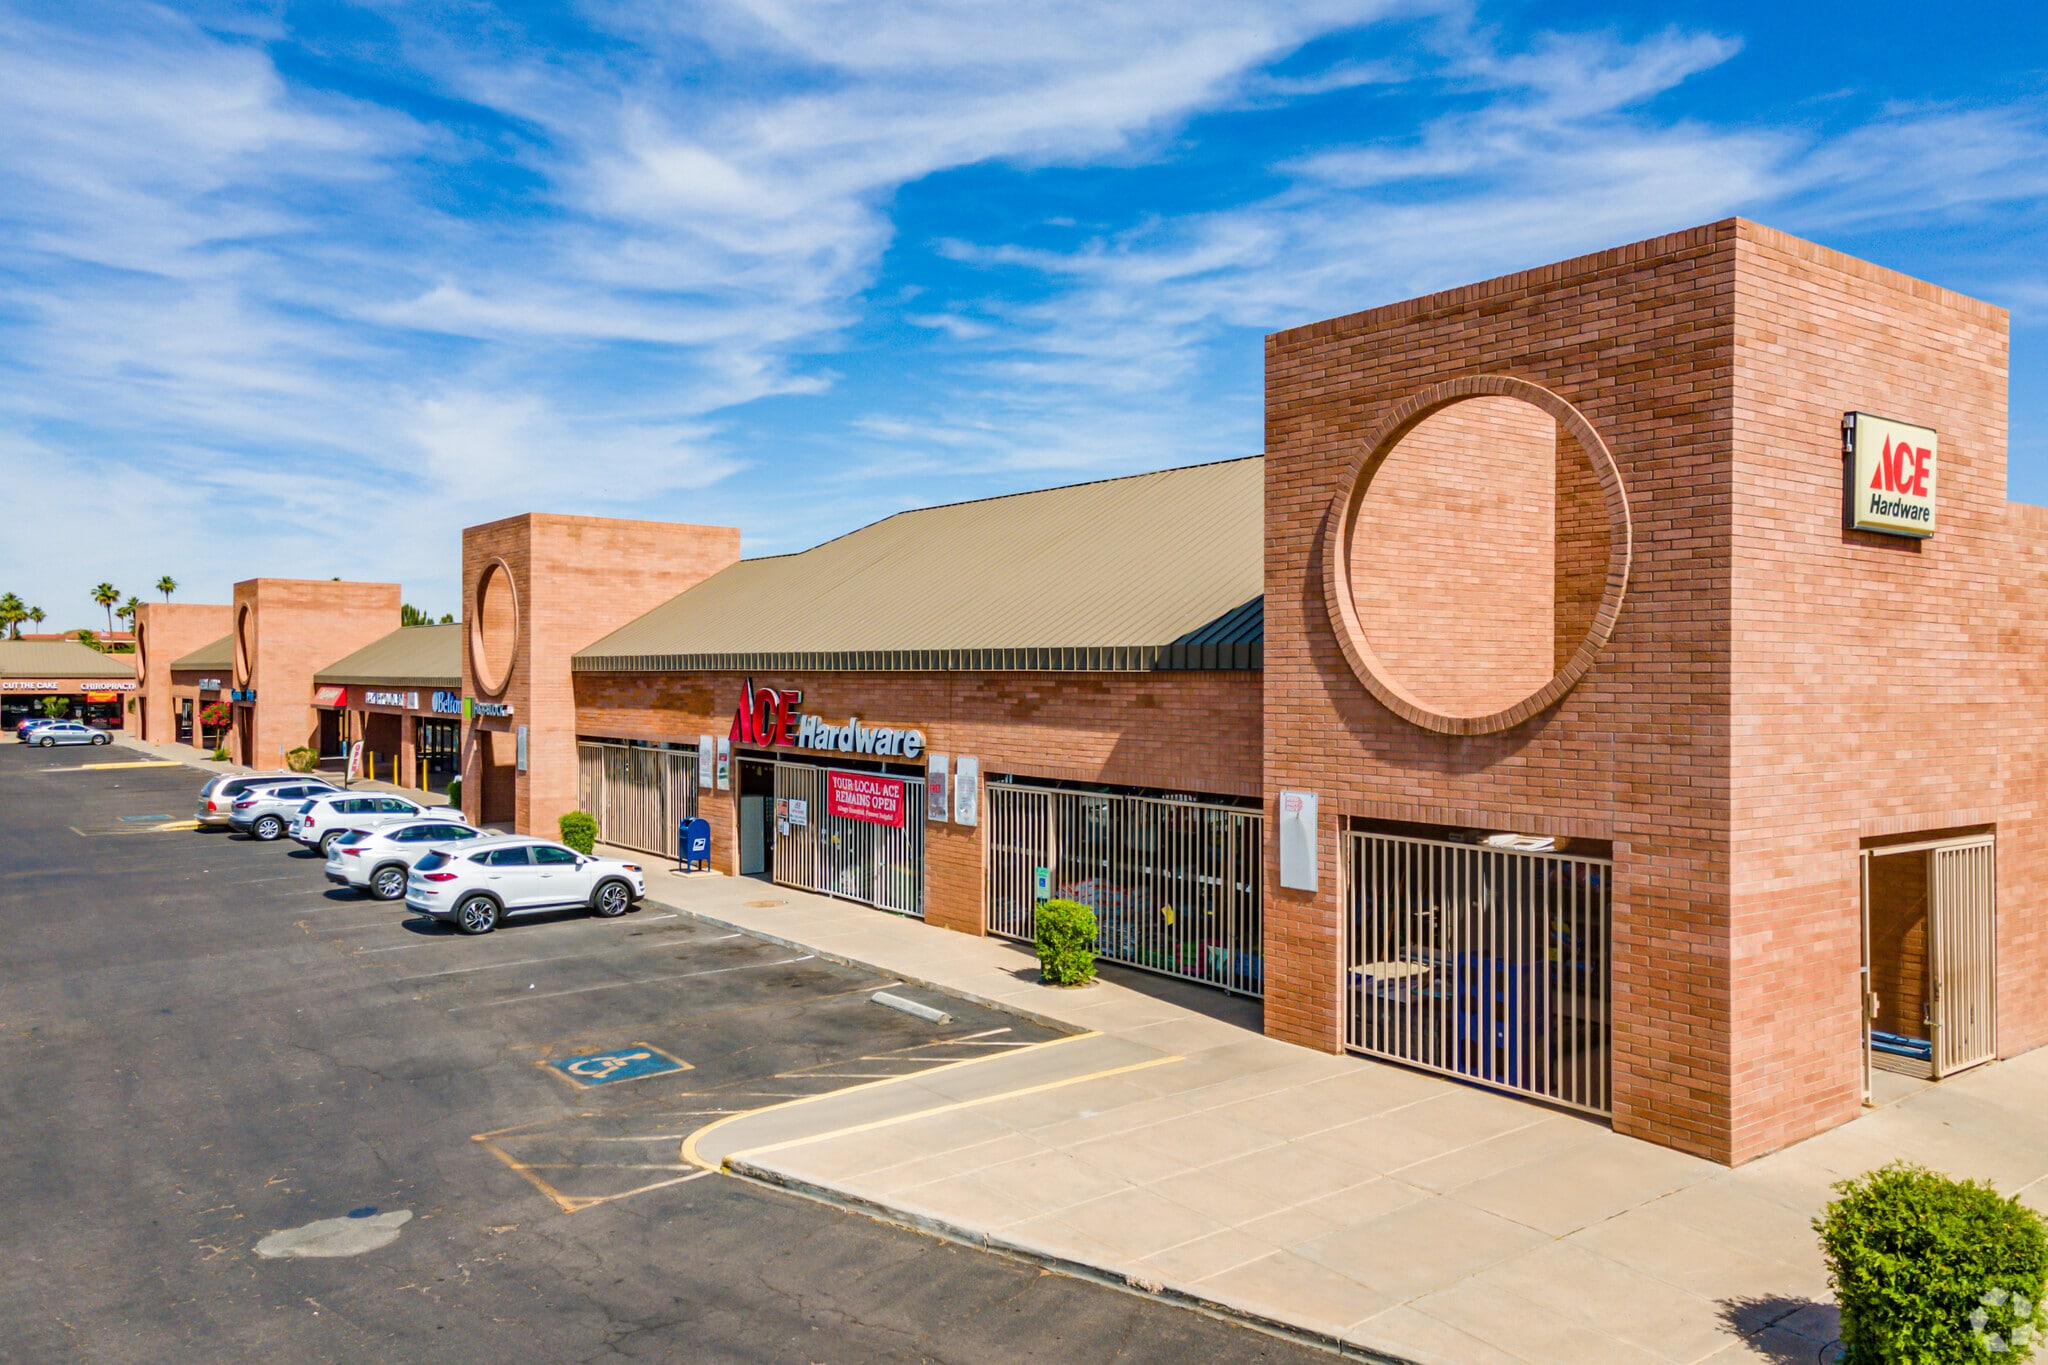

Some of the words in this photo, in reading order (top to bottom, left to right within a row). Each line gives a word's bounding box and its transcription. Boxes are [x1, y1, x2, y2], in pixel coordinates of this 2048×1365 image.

[1870, 432, 1931, 498] ACE
[1870, 493, 1930, 522] Hardware
[2, 681, 18, 690] CUT
[20, 681, 35, 690] THE
[36, 681, 58, 690] CAKE
[729, 677, 802, 747] ACE
[799, 714, 926, 759] Hardware
[832, 776, 853, 791] YOUR
[854, 780, 881, 795] LOCAL
[883, 784, 900, 799] ACE
[835, 790, 871, 807] REMAINS
[872, 796, 896, 812] OPEN
